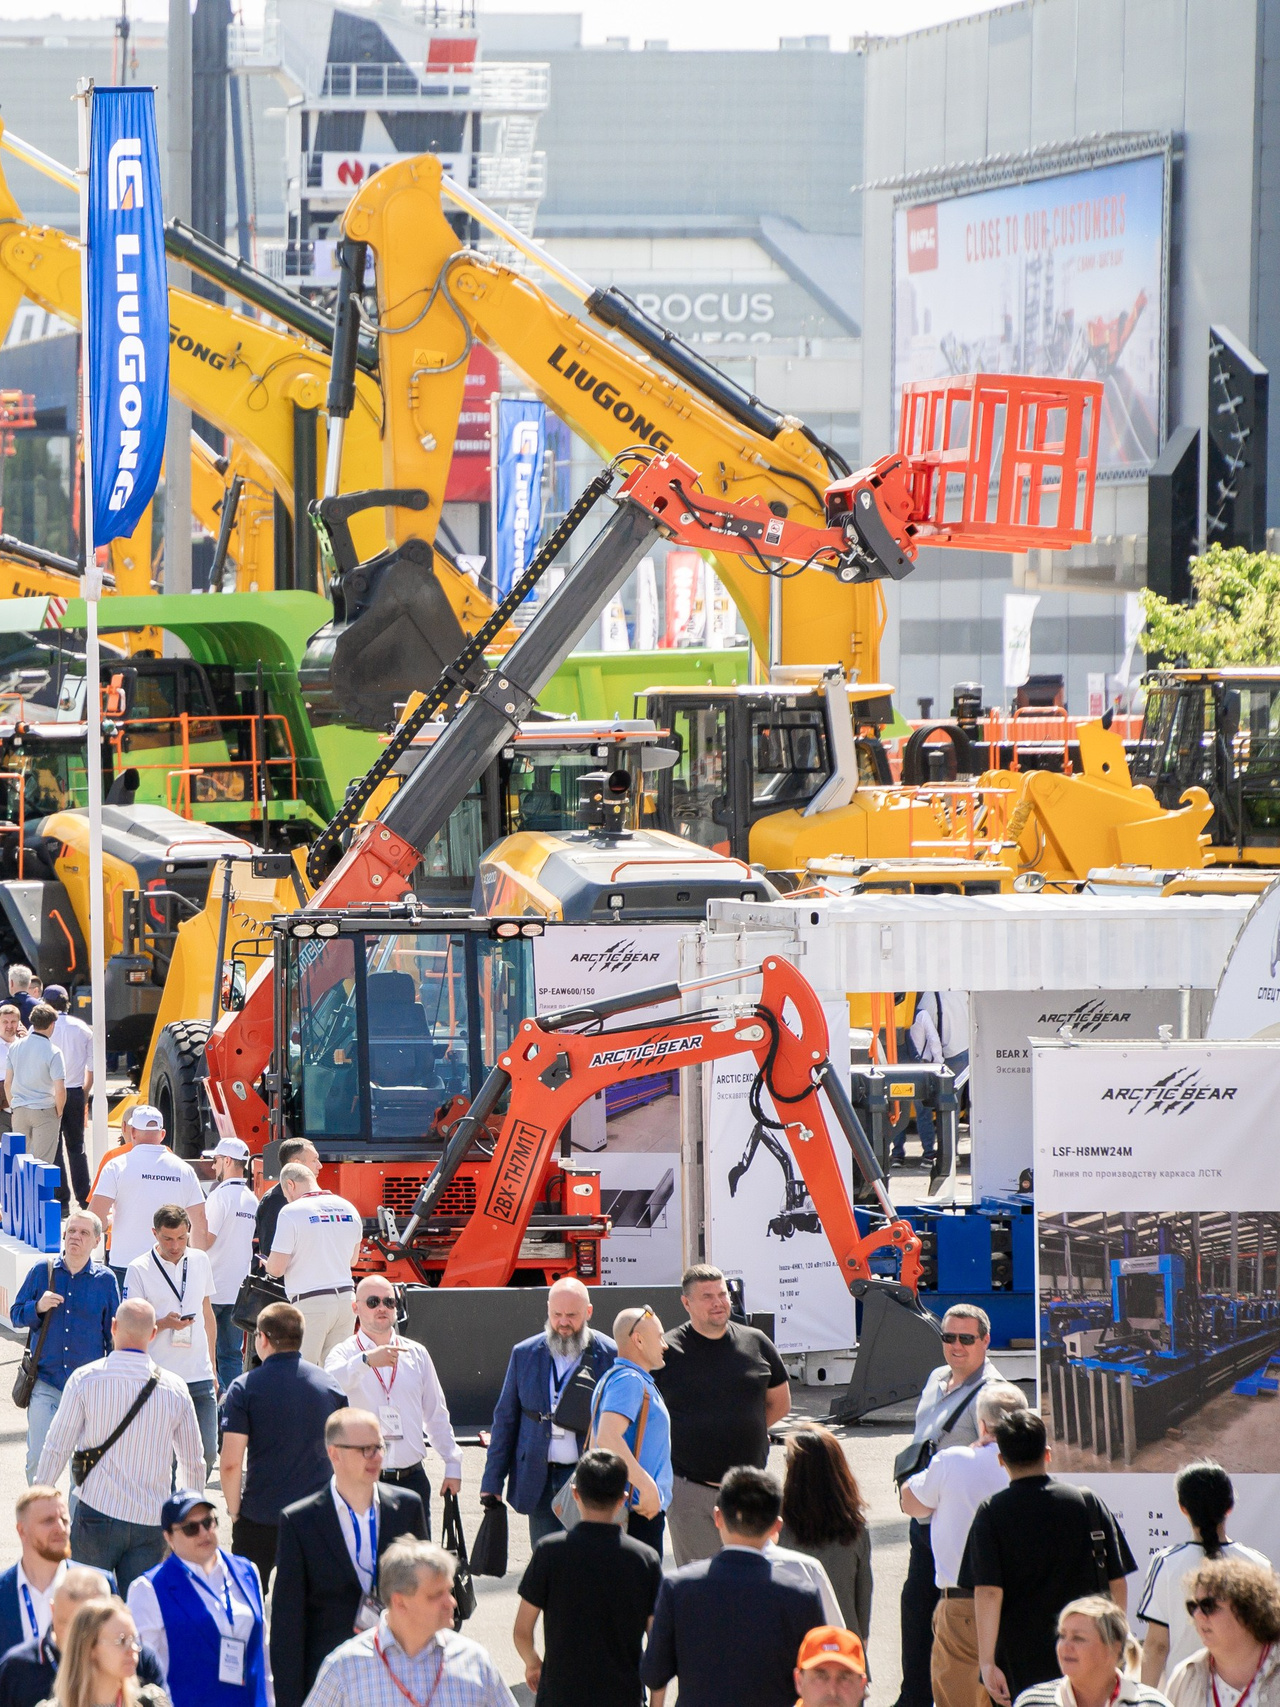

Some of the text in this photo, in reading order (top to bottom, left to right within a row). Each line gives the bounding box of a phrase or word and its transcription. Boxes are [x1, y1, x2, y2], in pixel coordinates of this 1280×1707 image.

[965, 194, 1127, 263] CLOSE TO OUR CUSTOMERS
[636, 292, 775, 324] ROCUS
[570, 952, 660, 962] ARCTIC BEAR
[538, 987, 596, 996] SP-EAW600/150
[1037, 1012, 1132, 1023] ARCTIC BEAR
[590, 1035, 704, 1067] ARCTIC BEAR
[995, 1049, 1029, 1059] BEAR X
[716, 1074, 742, 1084] ARCTIC
[1100, 1086, 1239, 1100] ARCTIC BEAR
[1052, 1169, 1078, 1178] Линия
[1095, 1171, 1157, 1179] производству
[1159, 1171, 1196, 1179] каркаса
[1198, 1169, 1222, 1178] ЛСТК
[1148, 1528, 1159, 1537] 24
